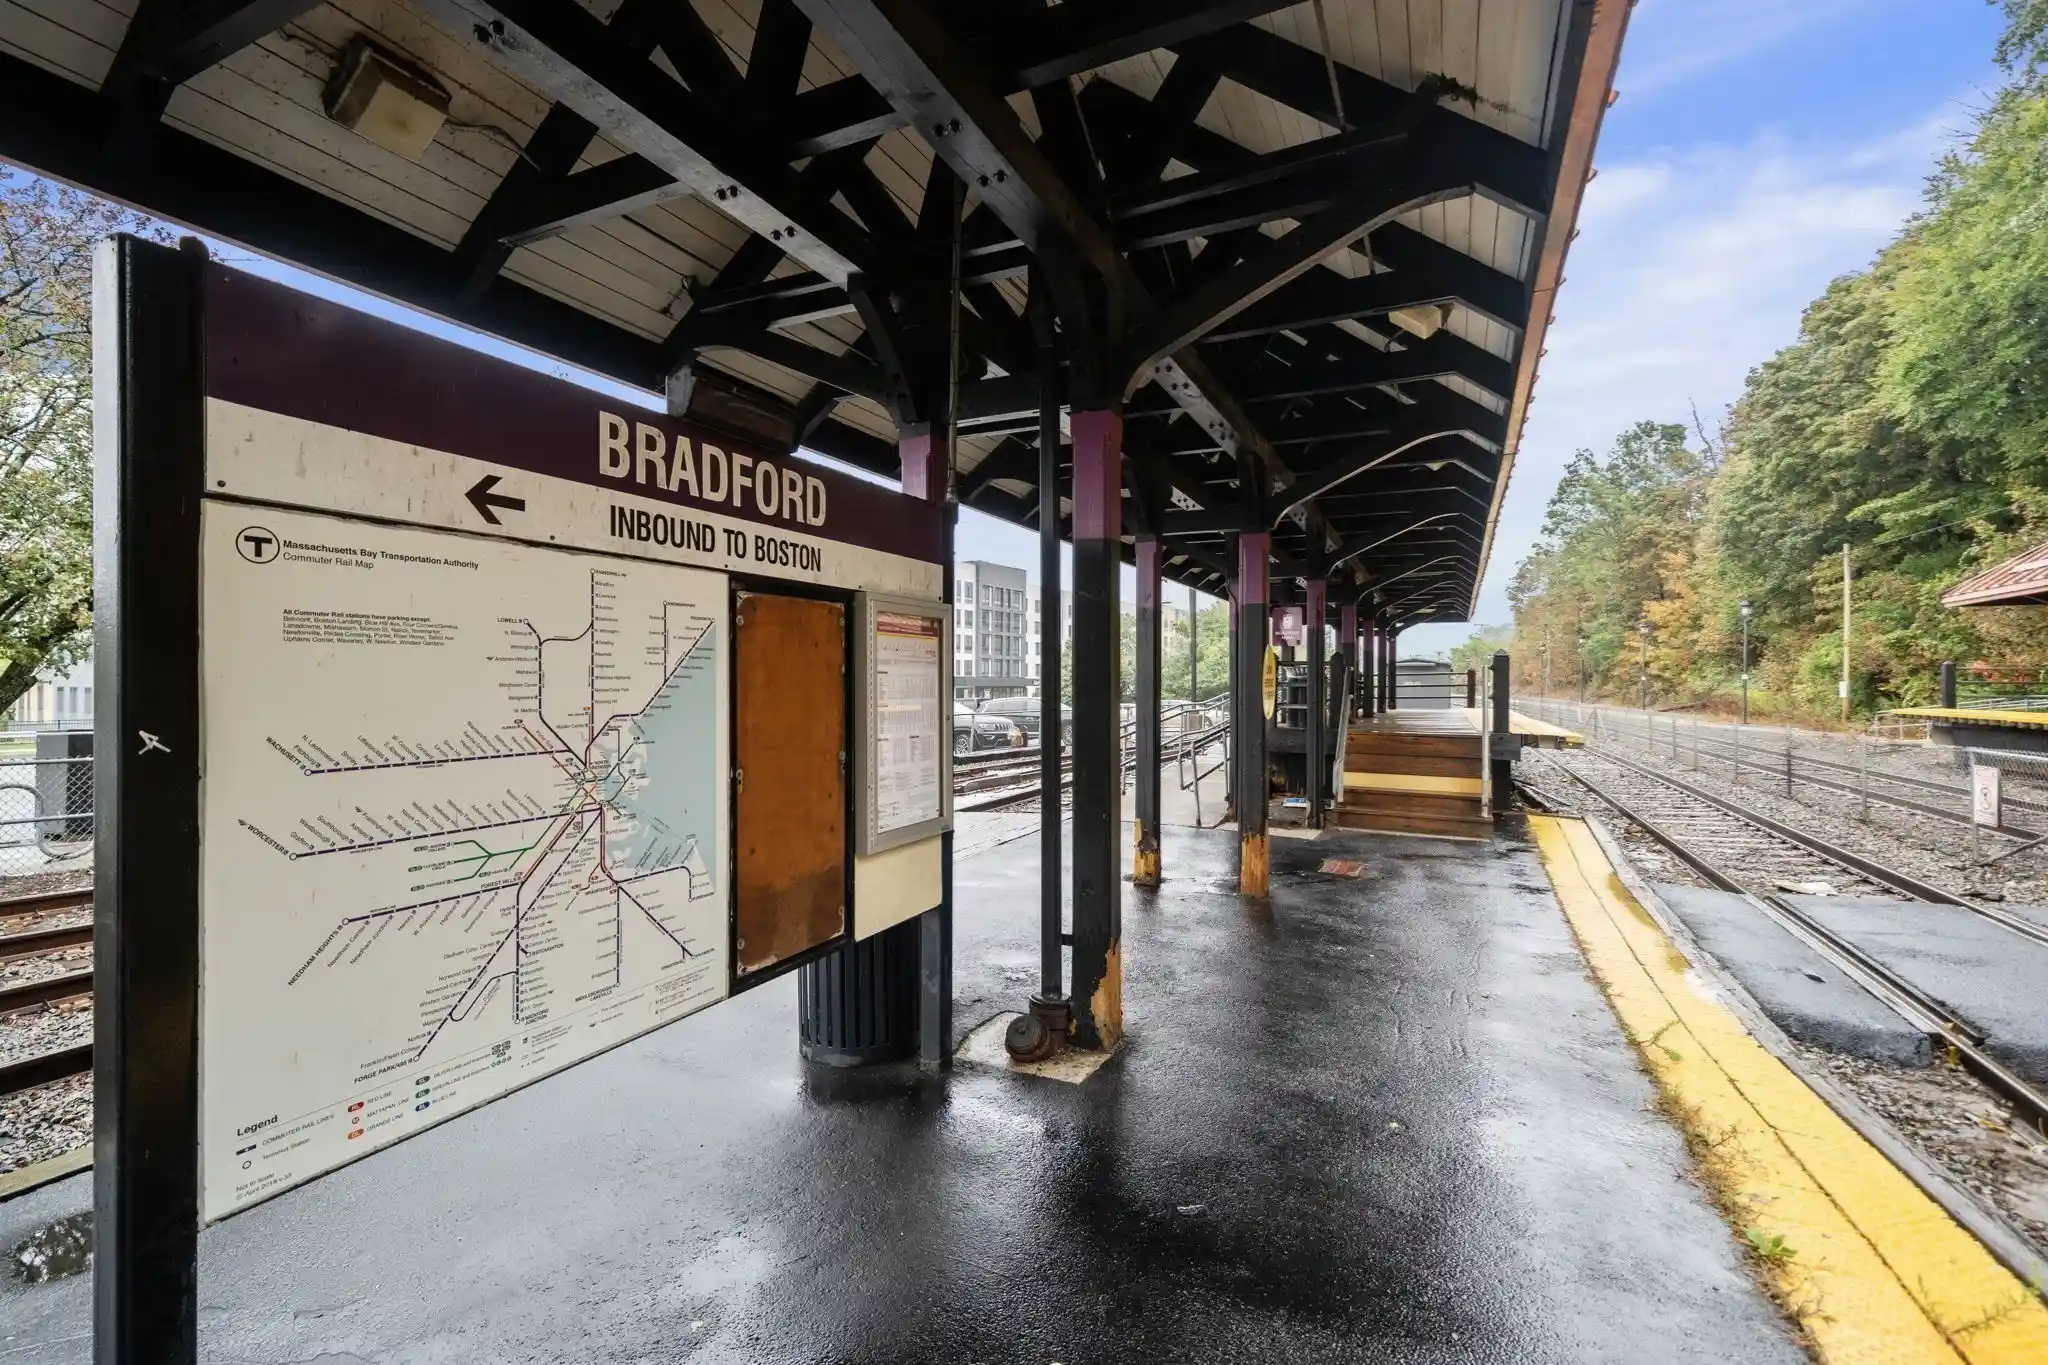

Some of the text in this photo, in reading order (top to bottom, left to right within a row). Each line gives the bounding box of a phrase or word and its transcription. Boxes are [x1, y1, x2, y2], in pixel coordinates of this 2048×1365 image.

[599, 410, 827, 527] BRADFORD
[610, 504, 822, 572] INBOUND TO BOSTON
[283, 539, 479, 570] Massachusetts Bay Transportation Authority
[283, 552, 374, 570] Commuter Rail Map
[266, 736, 302, 766] WACHUSETT
[247, 824, 285, 853] WORCESTER
[288, 930, 339, 986] NEEDHAM HEIGHTS
[328, 926, 366, 968] Needham Center
[350, 940, 372, 964] Needham
[354, 1070, 377, 1084] FORGE
[236, 1114, 278, 1137] Legend
[262, 1128, 301, 1146] COMMUTER
